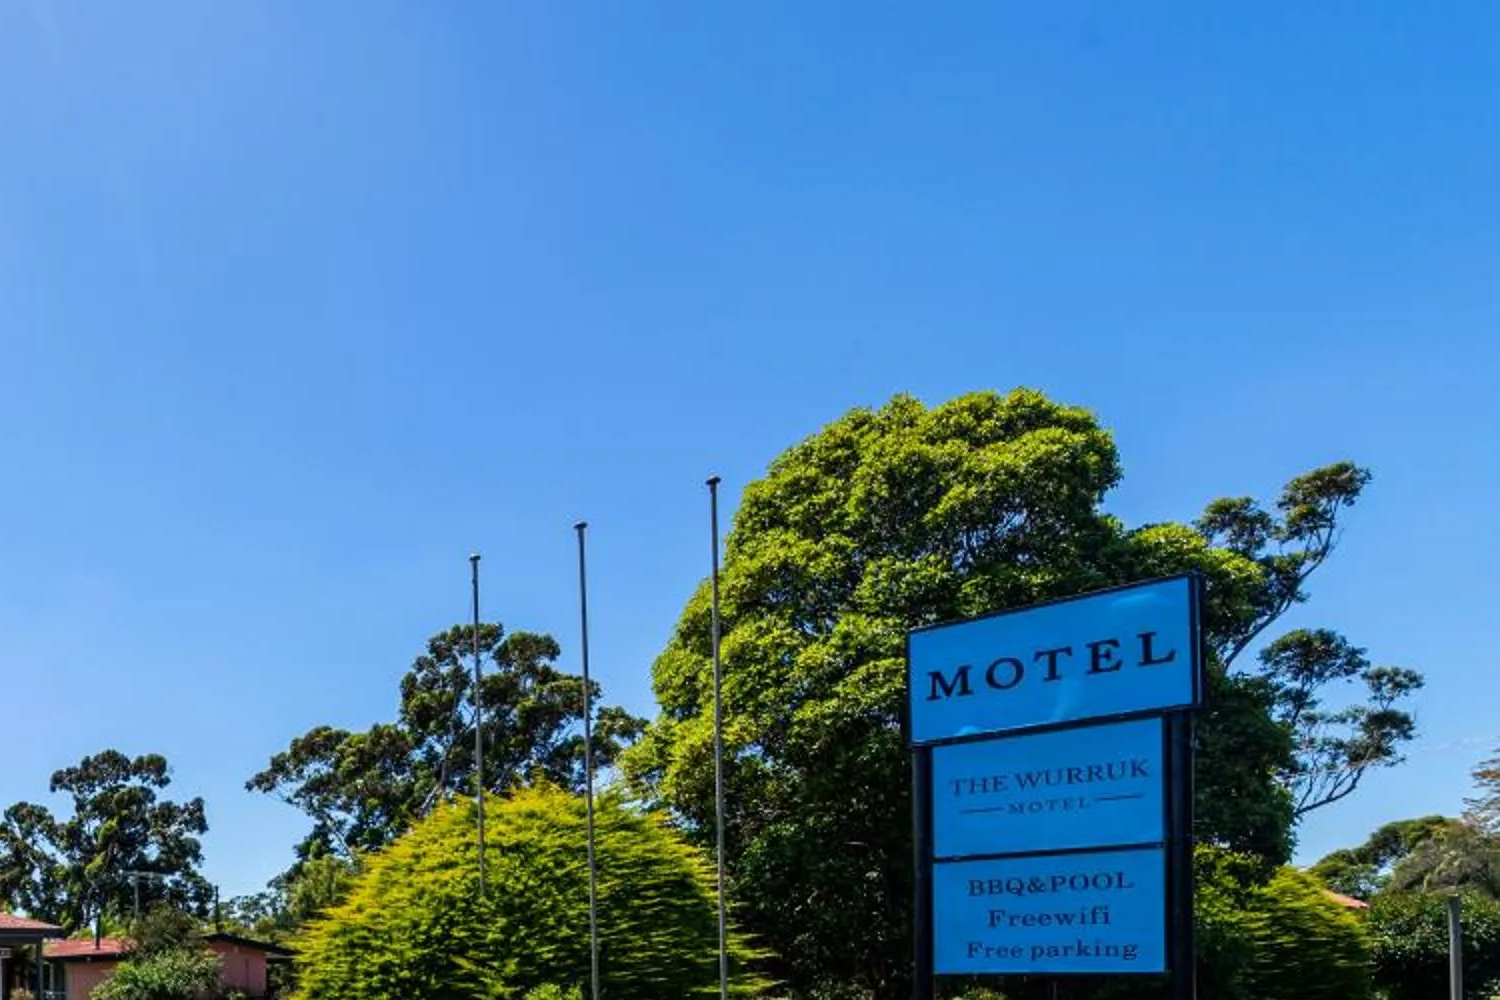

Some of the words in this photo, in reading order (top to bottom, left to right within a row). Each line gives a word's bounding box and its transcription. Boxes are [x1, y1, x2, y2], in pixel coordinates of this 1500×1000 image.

[926, 631, 1177, 701] MOTEL
[950, 775, 1009, 797] THE
[1014, 758, 1151, 792] WURRUK
[1007, 796, 1091, 815] MOTEL
[967, 871, 1135, 897] BBQ&POOL
[987, 904, 1111, 928] Freewifi
[966, 940, 1025, 959] Free
[1030, 938, 1139, 962] parking
